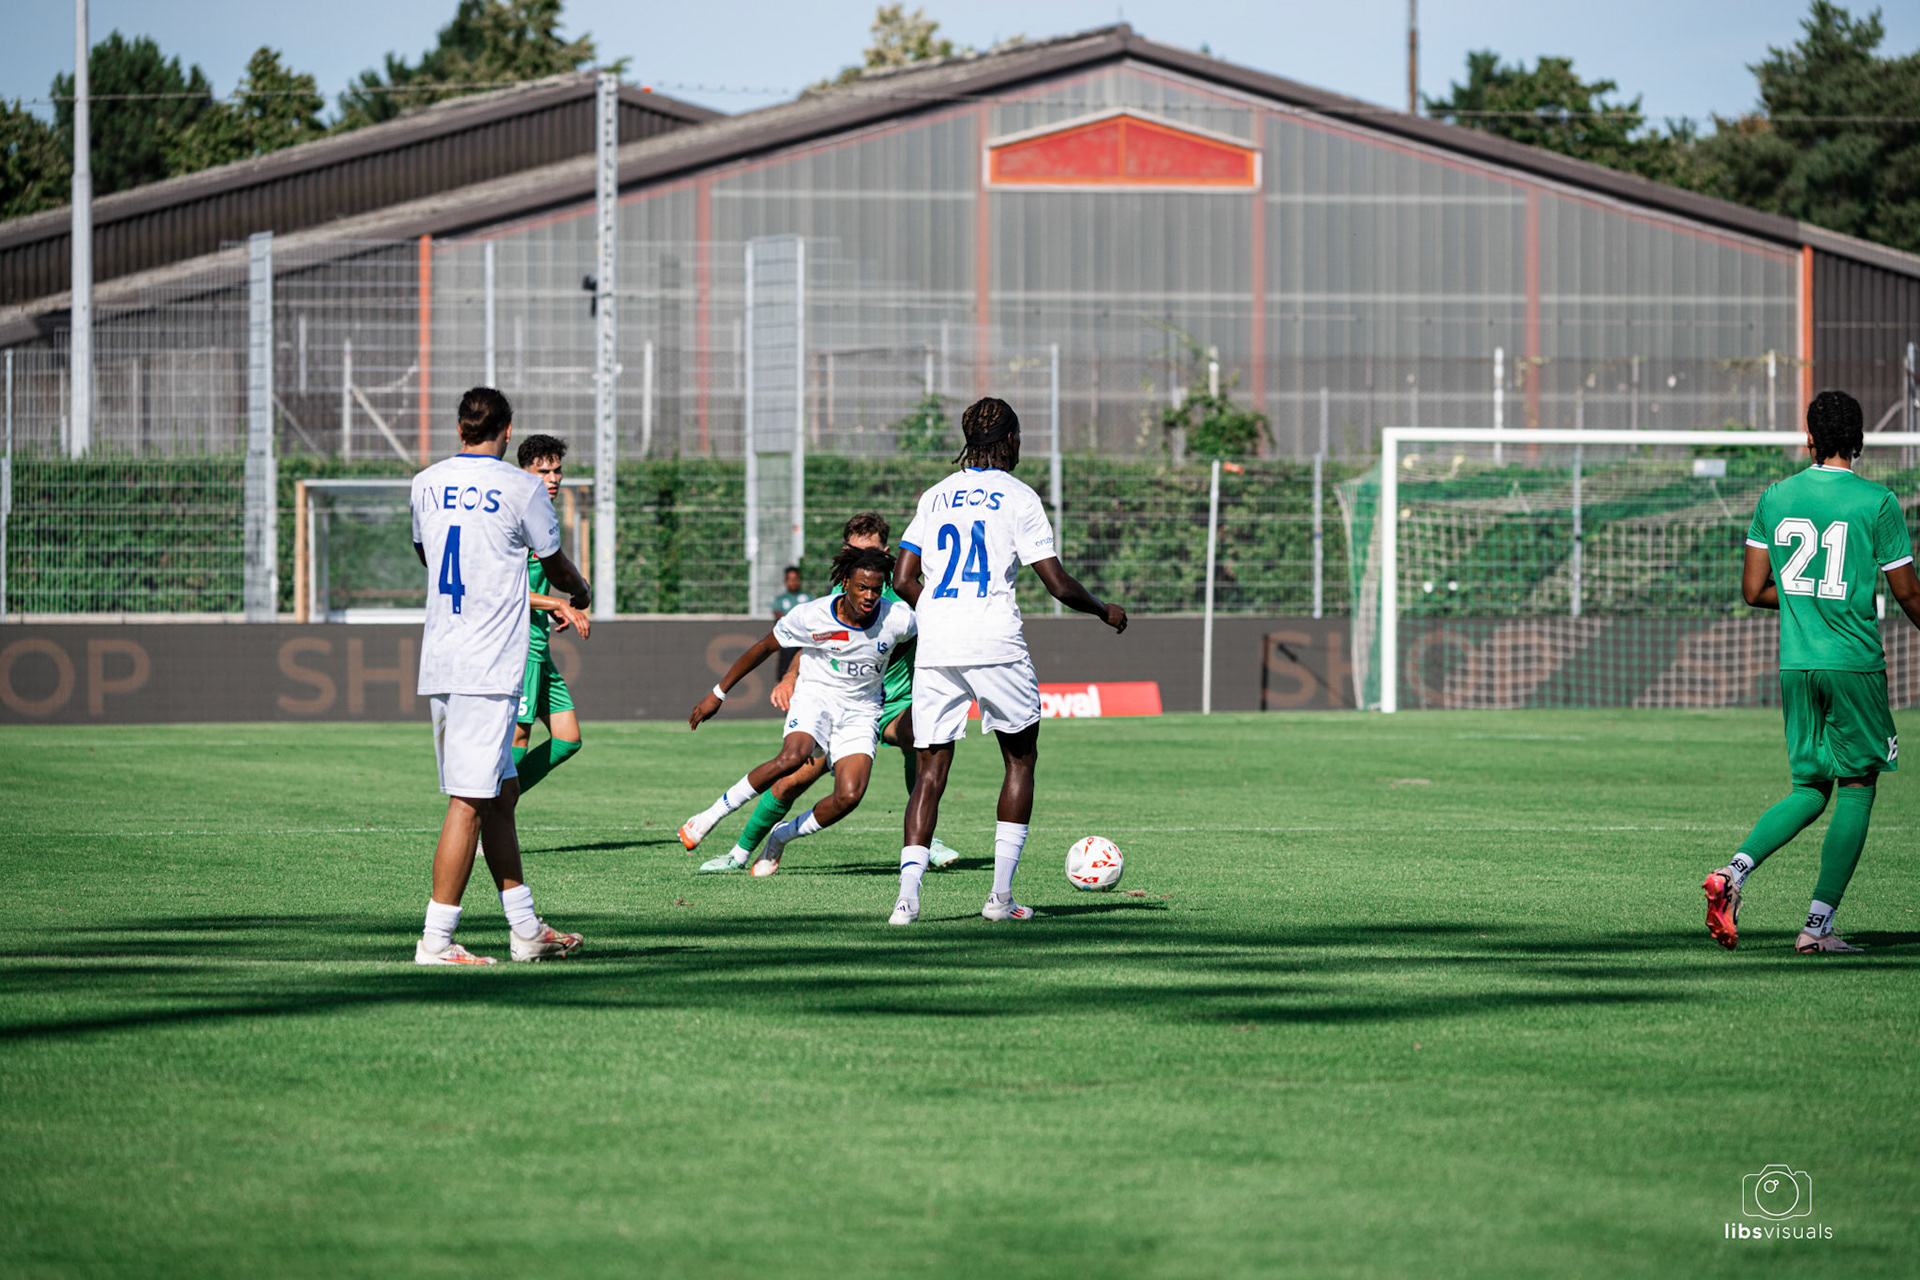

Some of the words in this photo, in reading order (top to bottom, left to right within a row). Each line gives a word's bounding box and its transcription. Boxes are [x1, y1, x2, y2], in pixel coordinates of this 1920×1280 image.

[421, 486, 502, 513] INEOS
[931, 488, 1005, 512] INEOS
[438, 525, 466, 615] 4
[932, 520, 991, 599] 24
[1774, 517, 1848, 600] 21
[1041, 684, 1102, 718] oval
